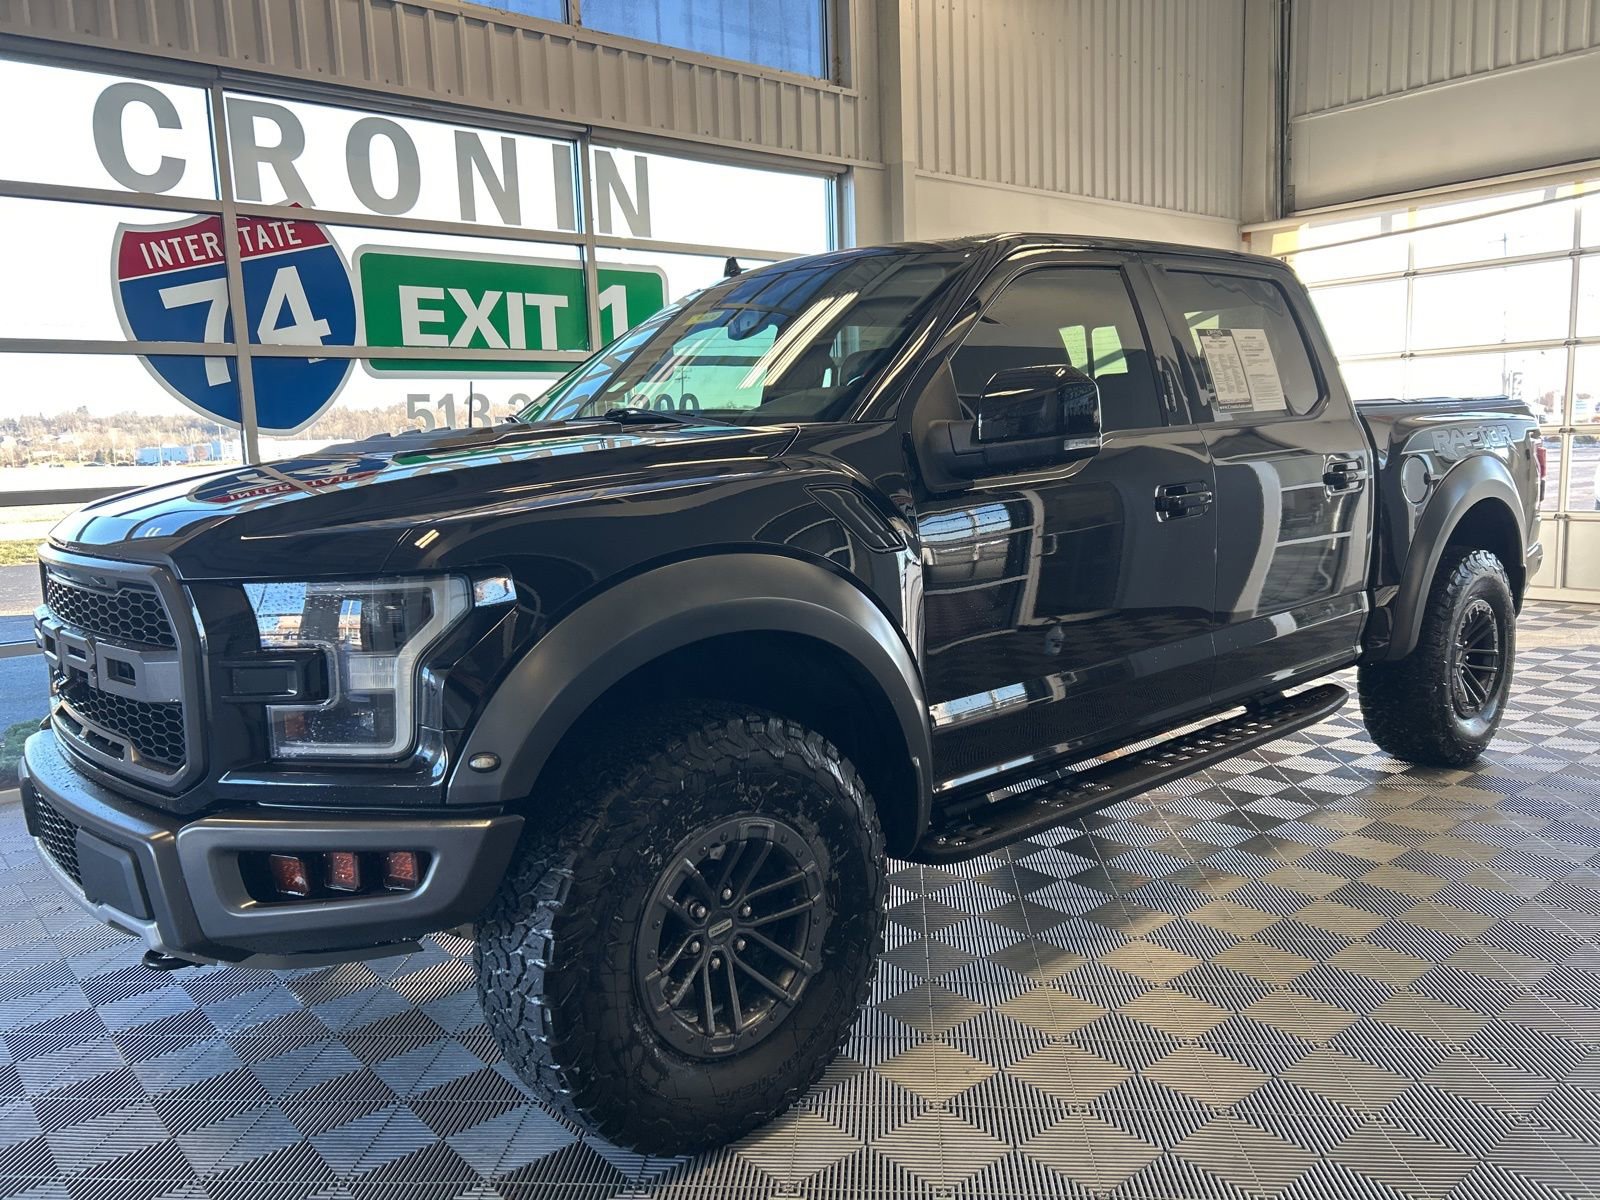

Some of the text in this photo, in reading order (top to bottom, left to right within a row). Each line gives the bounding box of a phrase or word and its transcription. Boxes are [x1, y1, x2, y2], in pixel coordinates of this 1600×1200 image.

[93, 82, 652, 238] CRONIN
[140, 221, 302, 270] INTERTATE
[159, 265, 332, 387] 74
[399, 284, 630, 351] EXIT 1
